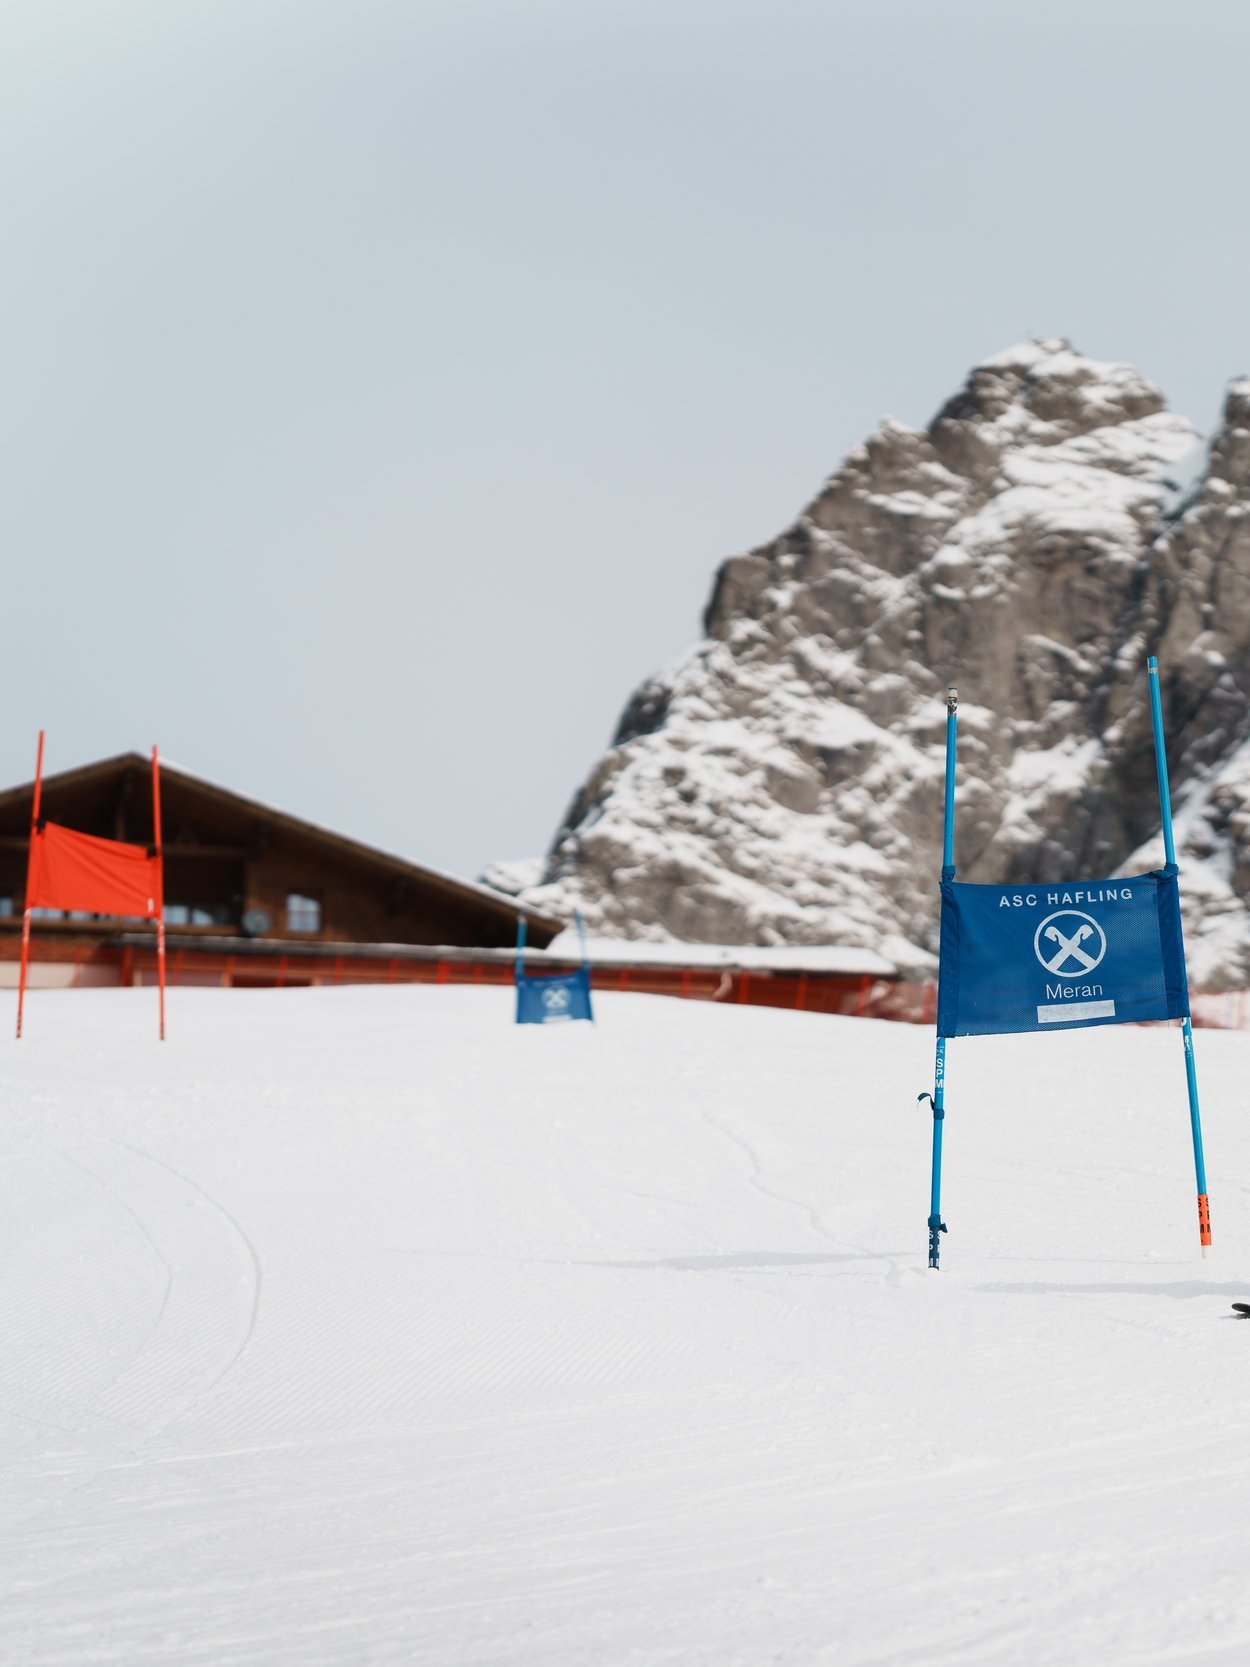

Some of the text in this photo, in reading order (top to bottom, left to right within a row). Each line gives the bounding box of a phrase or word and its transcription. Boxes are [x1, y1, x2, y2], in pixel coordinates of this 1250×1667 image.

[999, 888, 1133, 908] ASC HAFLING
[1045, 983, 1103, 999] Meran
